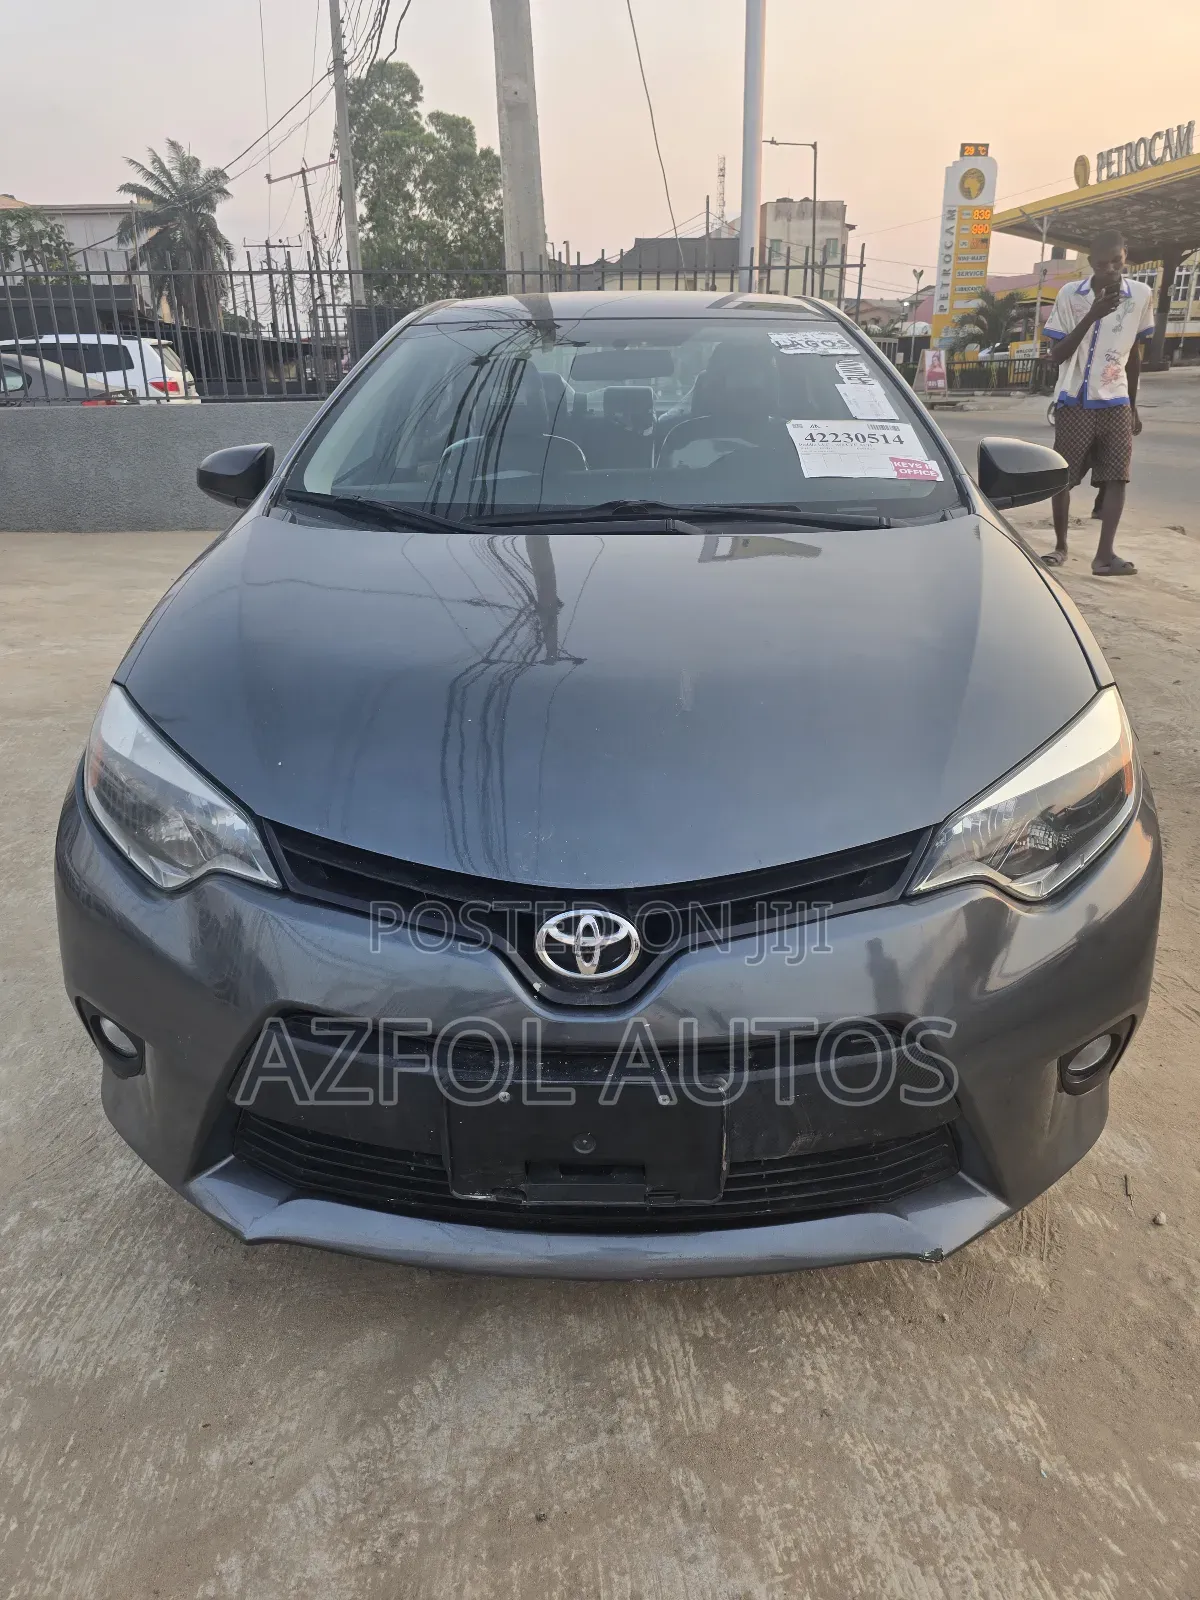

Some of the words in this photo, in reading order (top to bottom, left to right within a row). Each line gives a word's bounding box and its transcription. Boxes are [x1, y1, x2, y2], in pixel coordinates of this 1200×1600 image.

[964, 145, 975, 156] 29
[1096, 120, 1195, 183] PETROCAM
[971, 224, 989, 234] 990
[938, 208, 957, 312] PETROCAM
[804, 432, 905, 445] 42230514
[893, 461, 922, 469] KEYS
[899, 469, 938, 477] OFFICE
